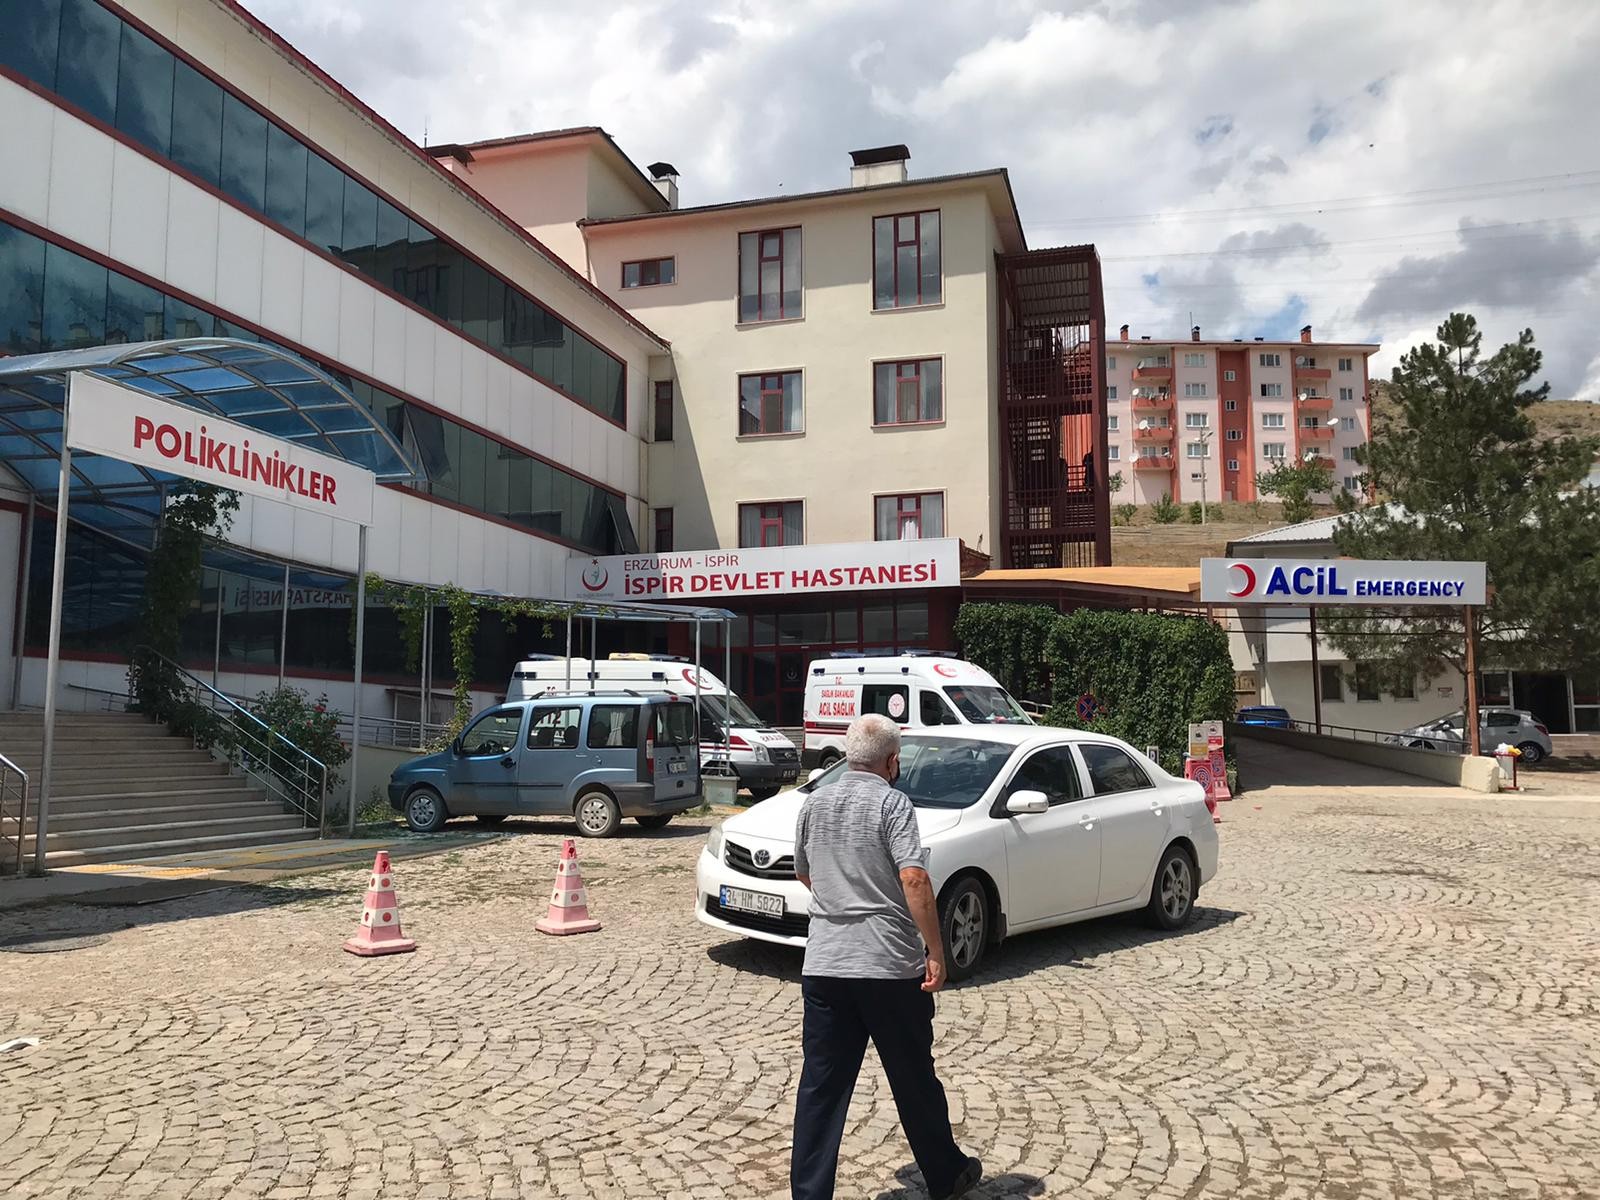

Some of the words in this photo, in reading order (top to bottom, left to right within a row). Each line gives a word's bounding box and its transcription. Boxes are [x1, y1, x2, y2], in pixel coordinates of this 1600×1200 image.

[133, 415, 337, 505] POLİKLİNİKLER
[624, 557, 692, 571] ERZURUM
[705, 553, 739, 568] İSPİR
[624, 573, 684, 595] İSPİR
[691, 571, 785, 592] DEVLET
[791, 559, 937, 588] HASTANESİ
[1356, 580, 1465, 597] EMERGENCY
[757, 894, 782, 913] 5822
